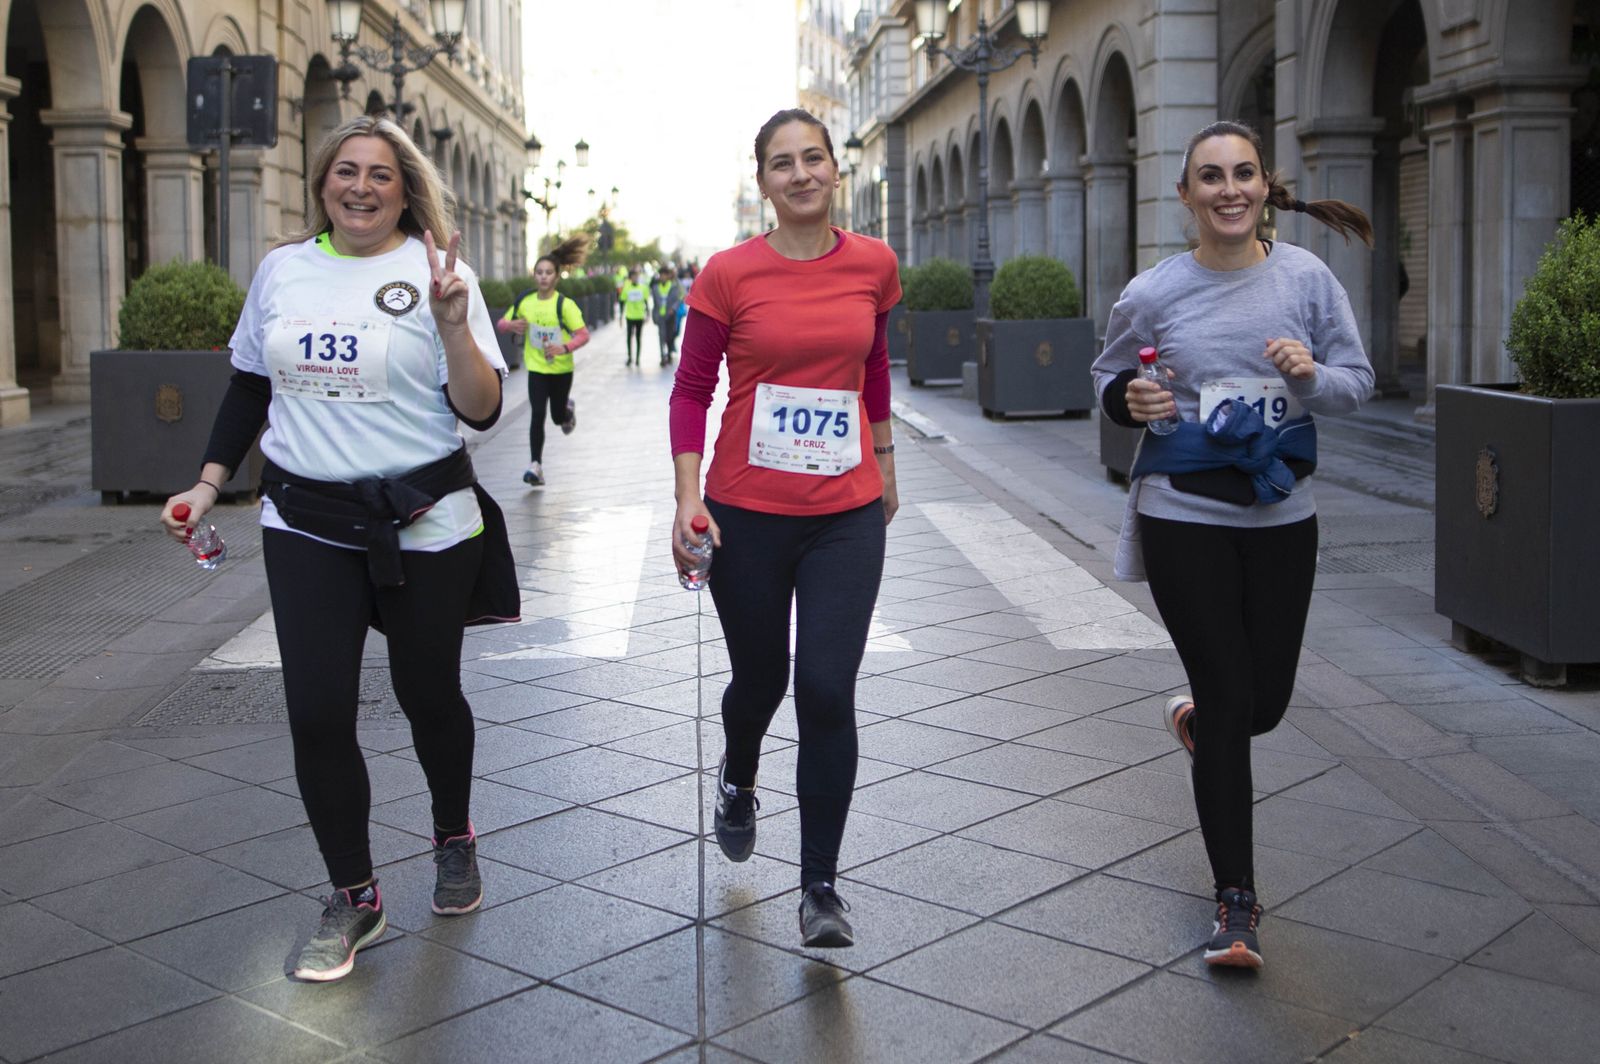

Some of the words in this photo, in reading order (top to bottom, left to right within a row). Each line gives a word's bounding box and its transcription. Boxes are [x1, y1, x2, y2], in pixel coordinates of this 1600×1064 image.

[298, 333, 358, 362] 133
[296, 364, 333, 374] VIRGINIA
[337, 367, 359, 375] LOVE
[773, 406, 849, 438] 1075
[1237, 396, 1288, 422] 19
[793, 439, 801, 447] M
[803, 440, 827, 449] CRUZ
